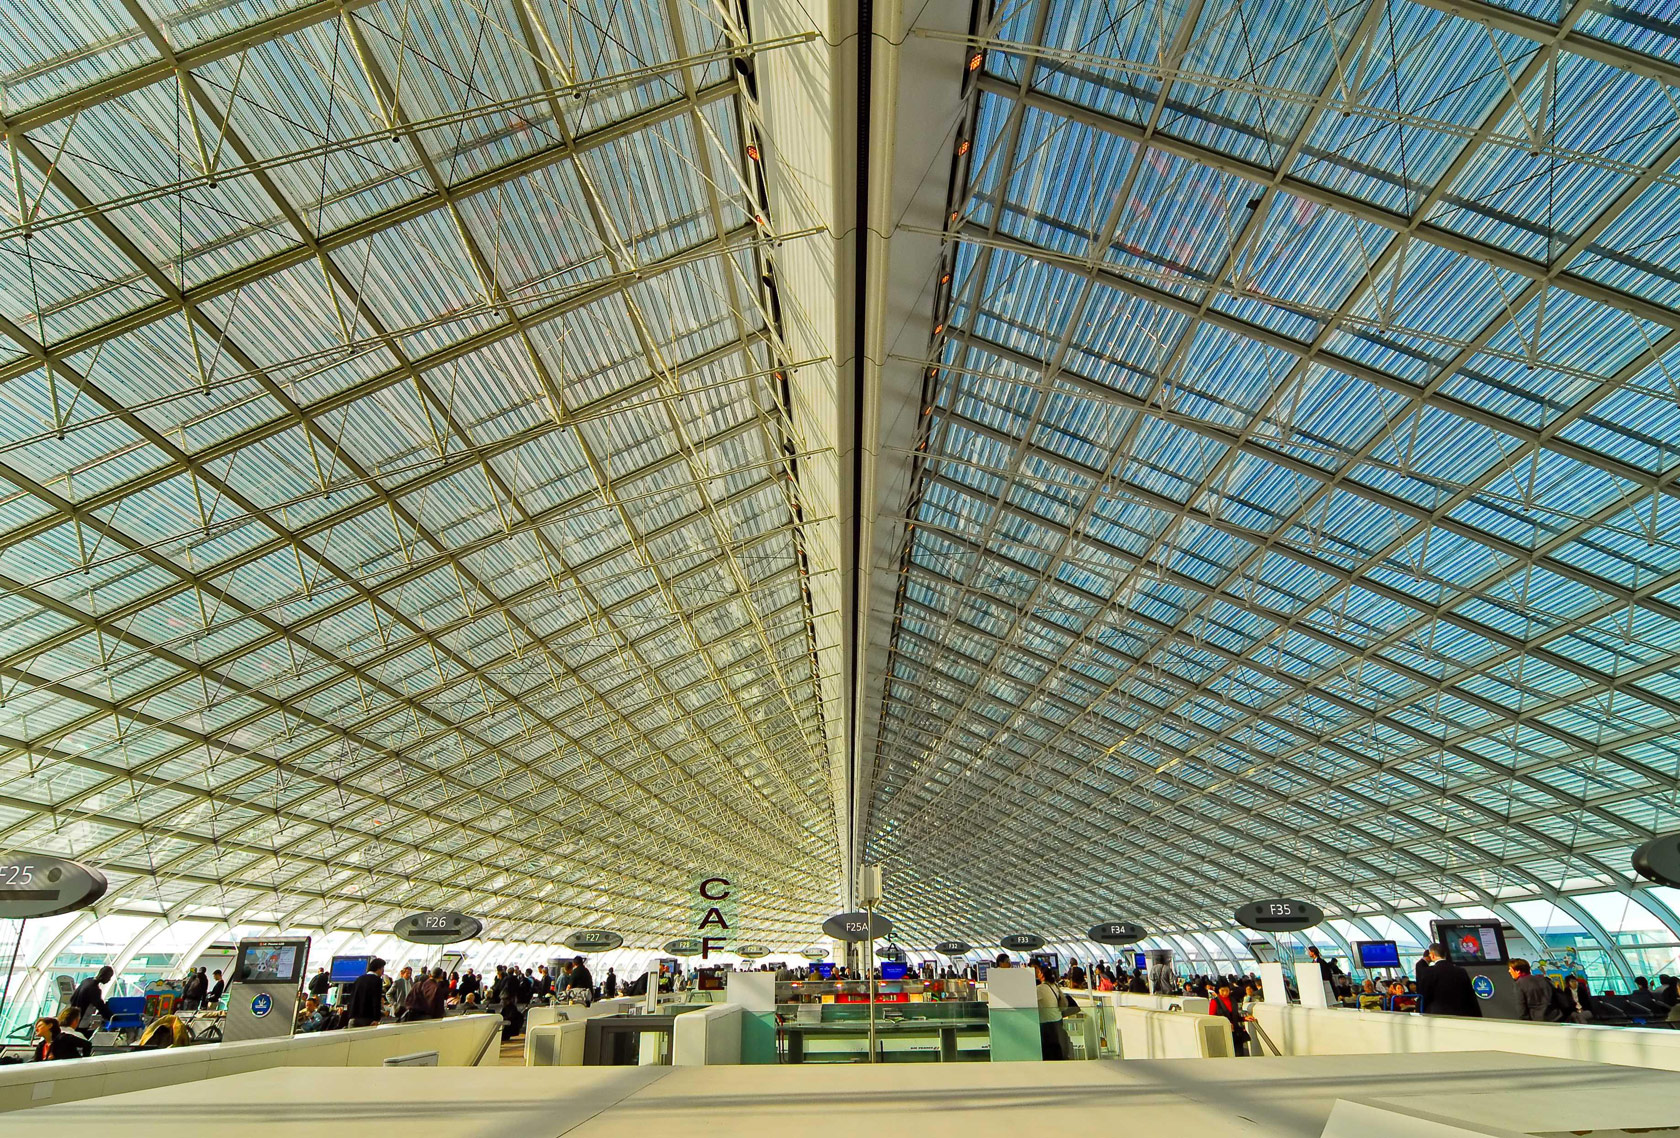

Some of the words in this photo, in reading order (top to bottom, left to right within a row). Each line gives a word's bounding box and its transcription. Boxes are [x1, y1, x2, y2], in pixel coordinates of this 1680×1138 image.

[1270, 903, 1291, 915] F35
[425, 916, 447, 928] F26
[846, 922, 869, 932] F25A
[1110, 925, 1126, 934] F34
[586, 933, 600, 942] F27
[1017, 936, 1029, 944] F33
